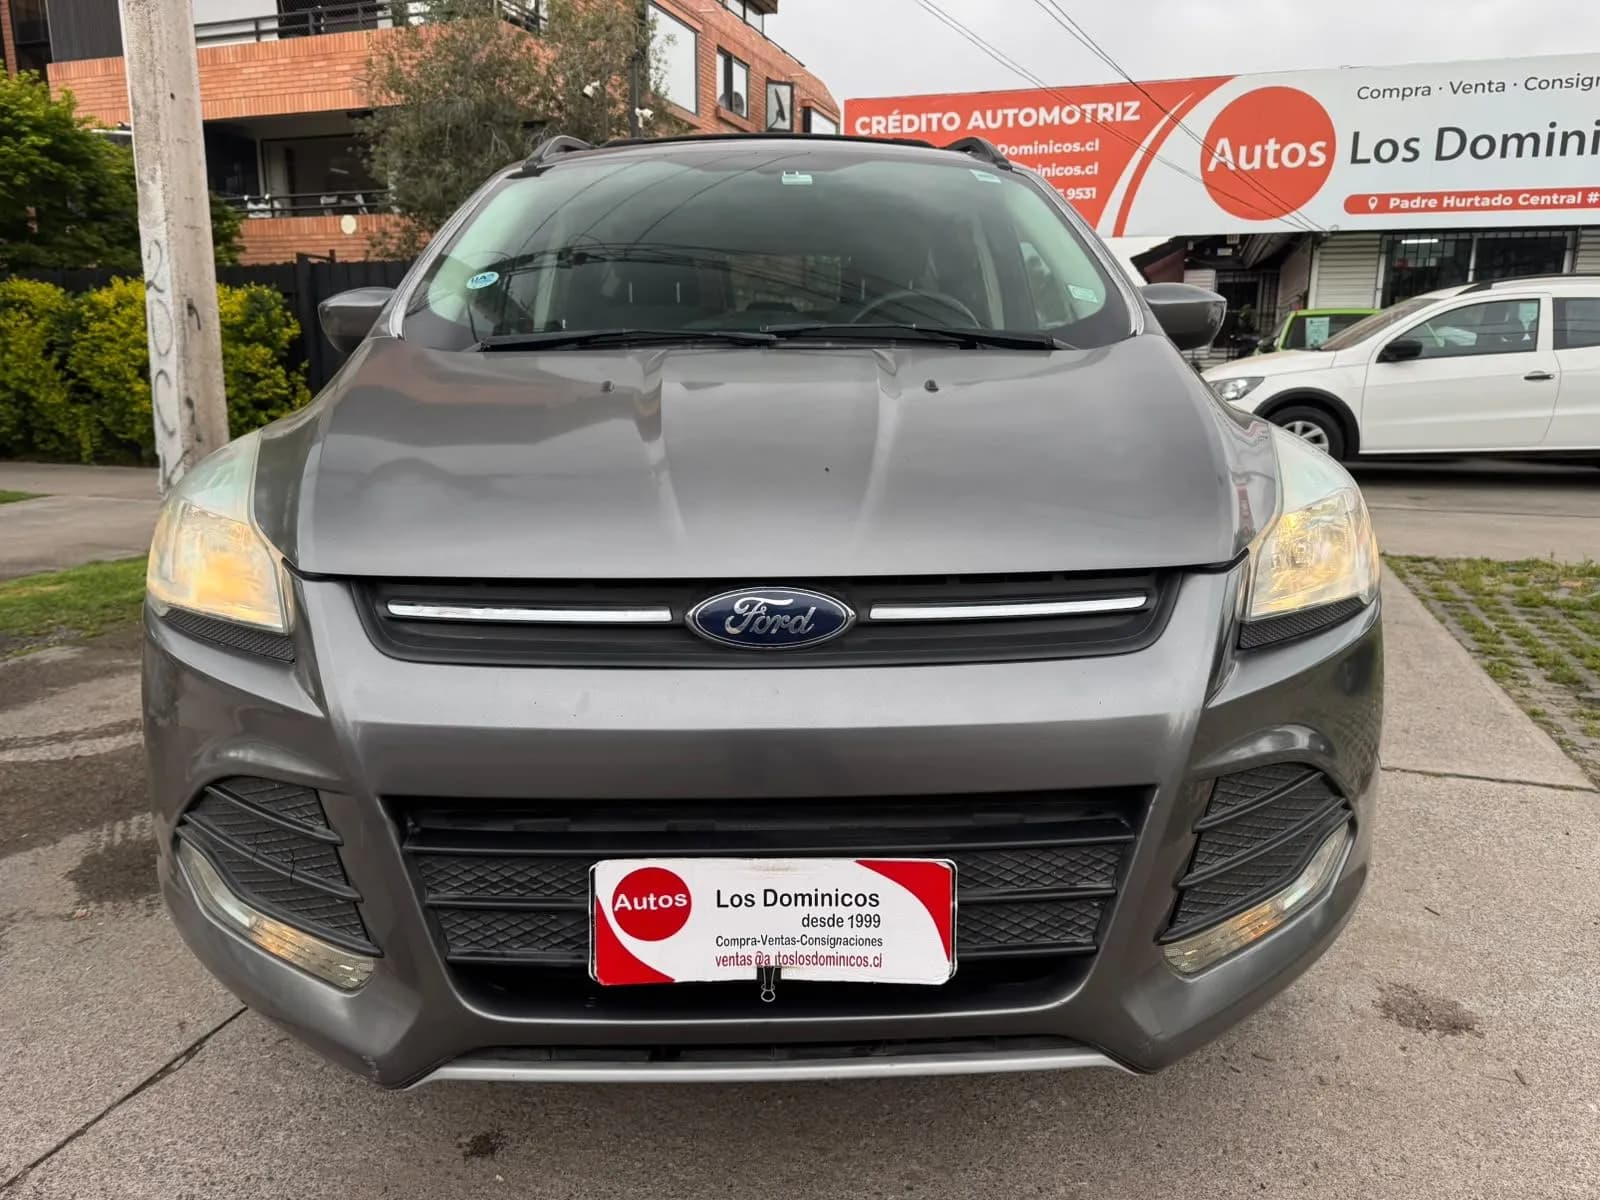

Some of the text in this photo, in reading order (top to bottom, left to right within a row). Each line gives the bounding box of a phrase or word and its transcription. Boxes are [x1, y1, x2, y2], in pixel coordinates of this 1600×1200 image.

[1357, 84, 1432, 101] Compra
[1449, 78, 1506, 95] Venta
[855, 101, 1141, 135] CRÉDITO AUTOMOTRIZ
[1350, 119, 1600, 165] Los Domini
[1207, 137, 1327, 172] Autos
[1389, 196, 1438, 209] Padre
[1442, 193, 1513, 208] Hurtado
[1518, 191, 1582, 206] Central
[725, 597, 816, 634] Ford
[613, 893, 688, 912] Autos
[716, 888, 880, 908] Los Dominicos
[801, 913, 881, 929] desde 1999
